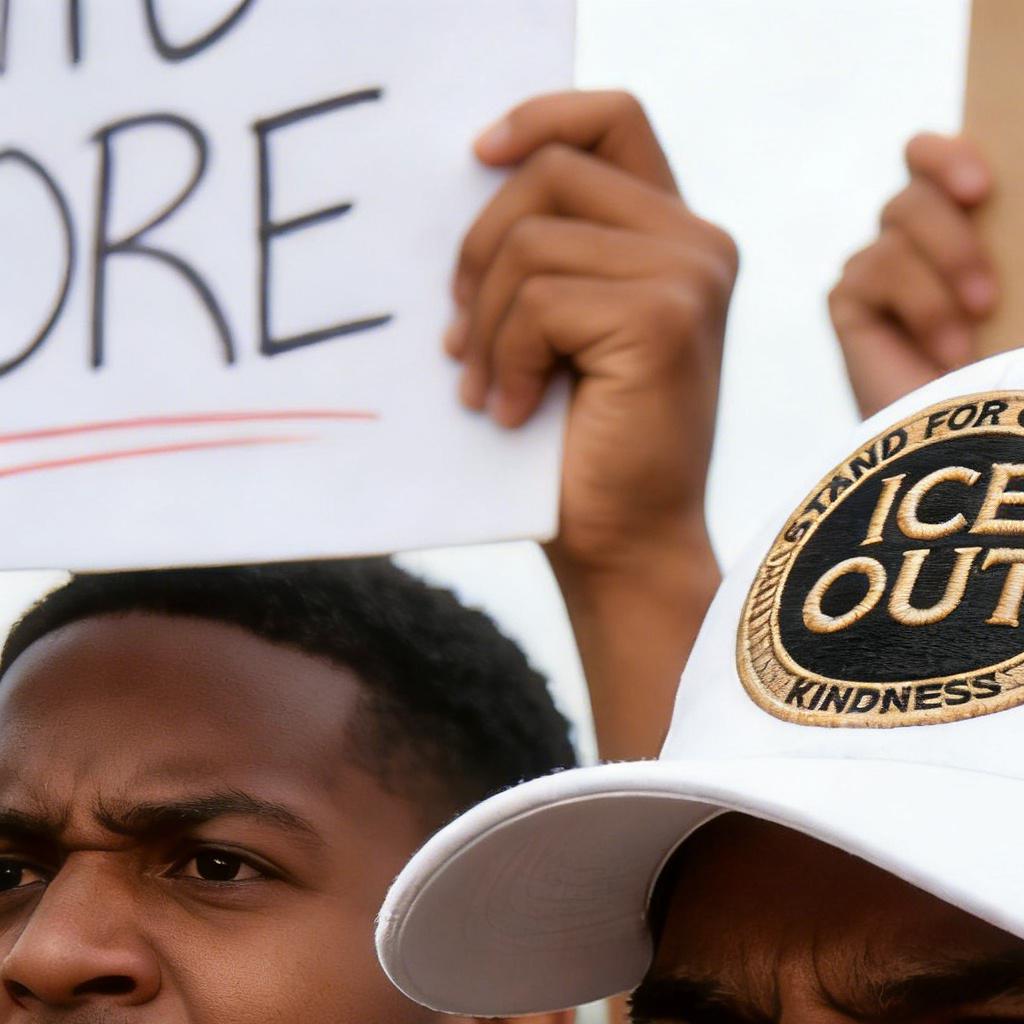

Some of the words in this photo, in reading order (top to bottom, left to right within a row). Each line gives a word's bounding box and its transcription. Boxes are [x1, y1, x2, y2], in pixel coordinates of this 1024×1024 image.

[784, 428, 908, 542] STAND
[924, 400, 1008, 440] FOR
[784, 671, 1002, 714] KINDNESS
